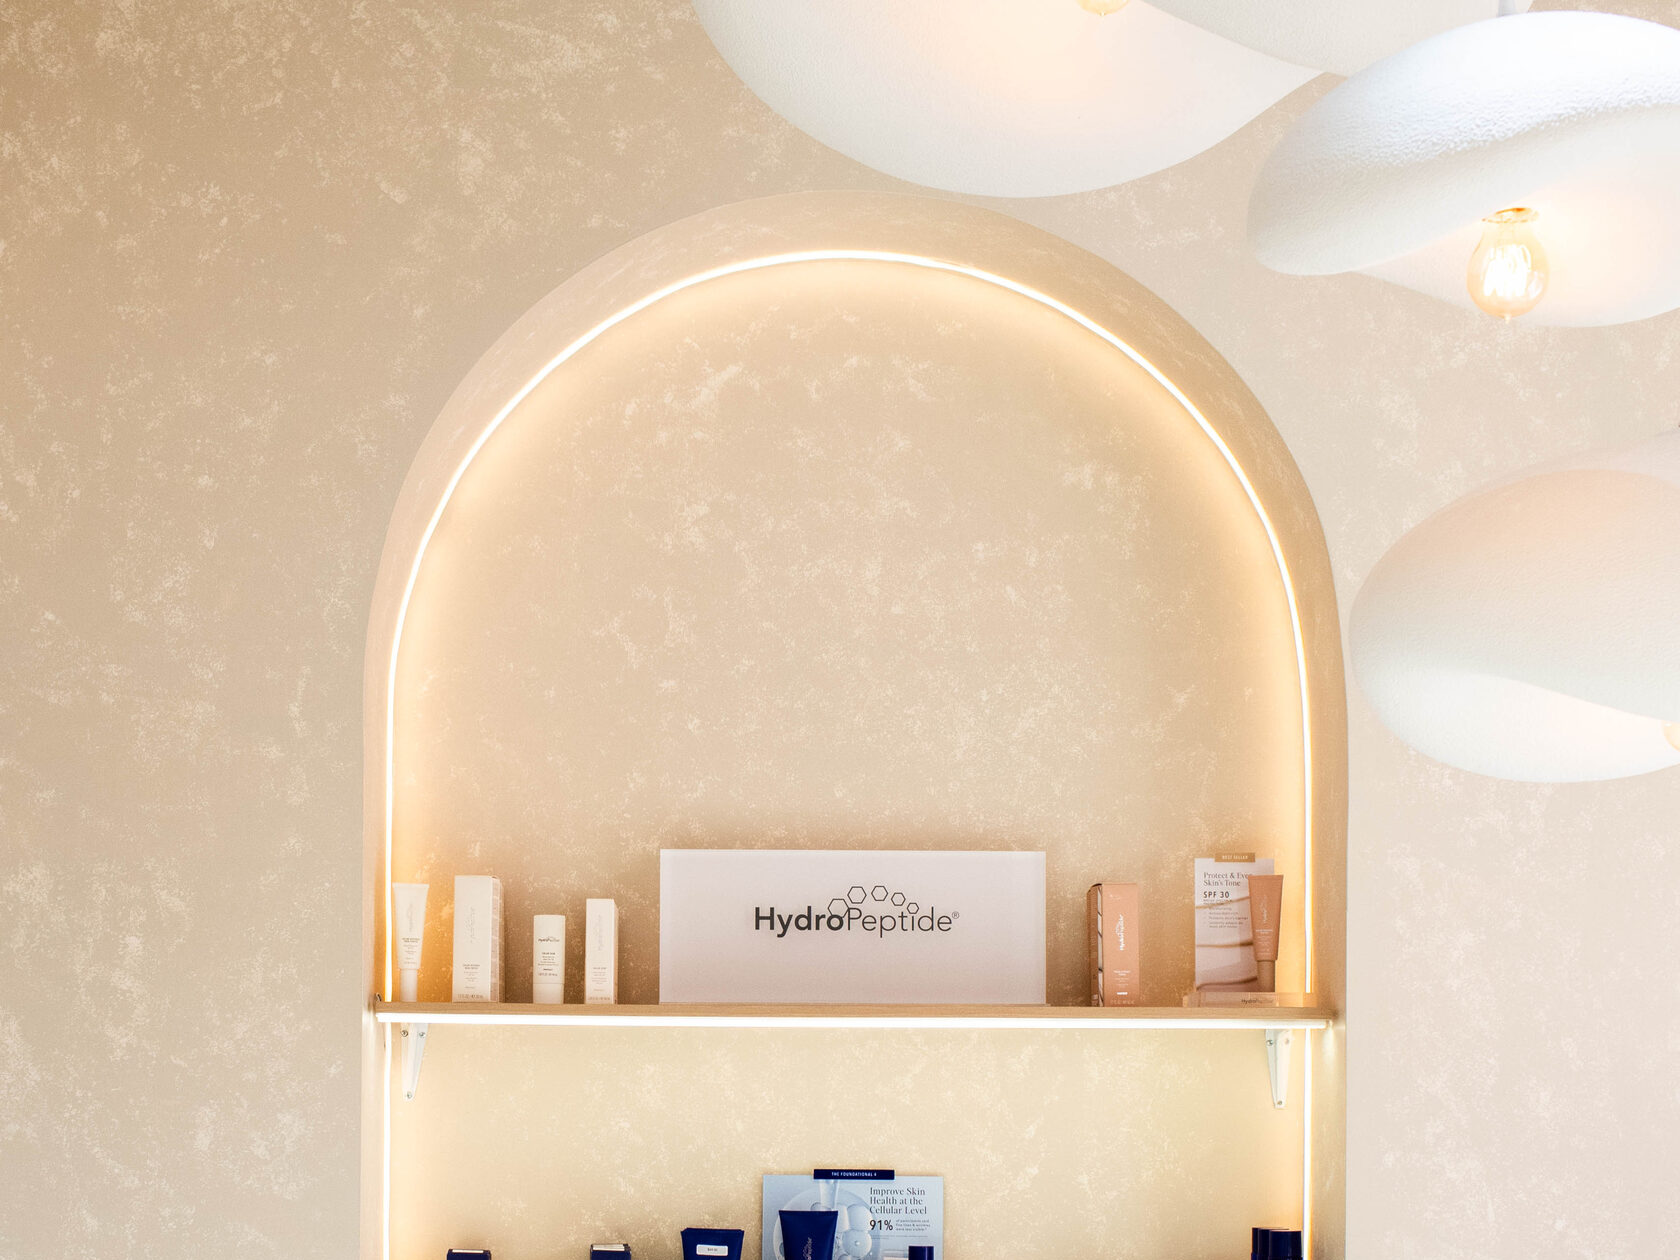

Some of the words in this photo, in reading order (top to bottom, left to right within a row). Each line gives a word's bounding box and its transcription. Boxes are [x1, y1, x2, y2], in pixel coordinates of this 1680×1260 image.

[1203, 871, 1228, 879] Protect
[1203, 879, 1224, 887] Skin's
[1224, 879, 1241, 887] Tone
[1203, 890, 1217, 898] SPF
[1219, 890, 1230, 898] 30
[869, 1186, 905, 1197] Improve
[906, 1186, 926, 1196] Skin
[869, 1196, 898, 1205] Health
[899, 1197, 907, 1205] at
[909, 1196, 923, 1205] the
[869, 1205, 903, 1214] Cellular
[904, 1205, 927, 1214] Level
[869, 1219, 894, 1231] 91%
